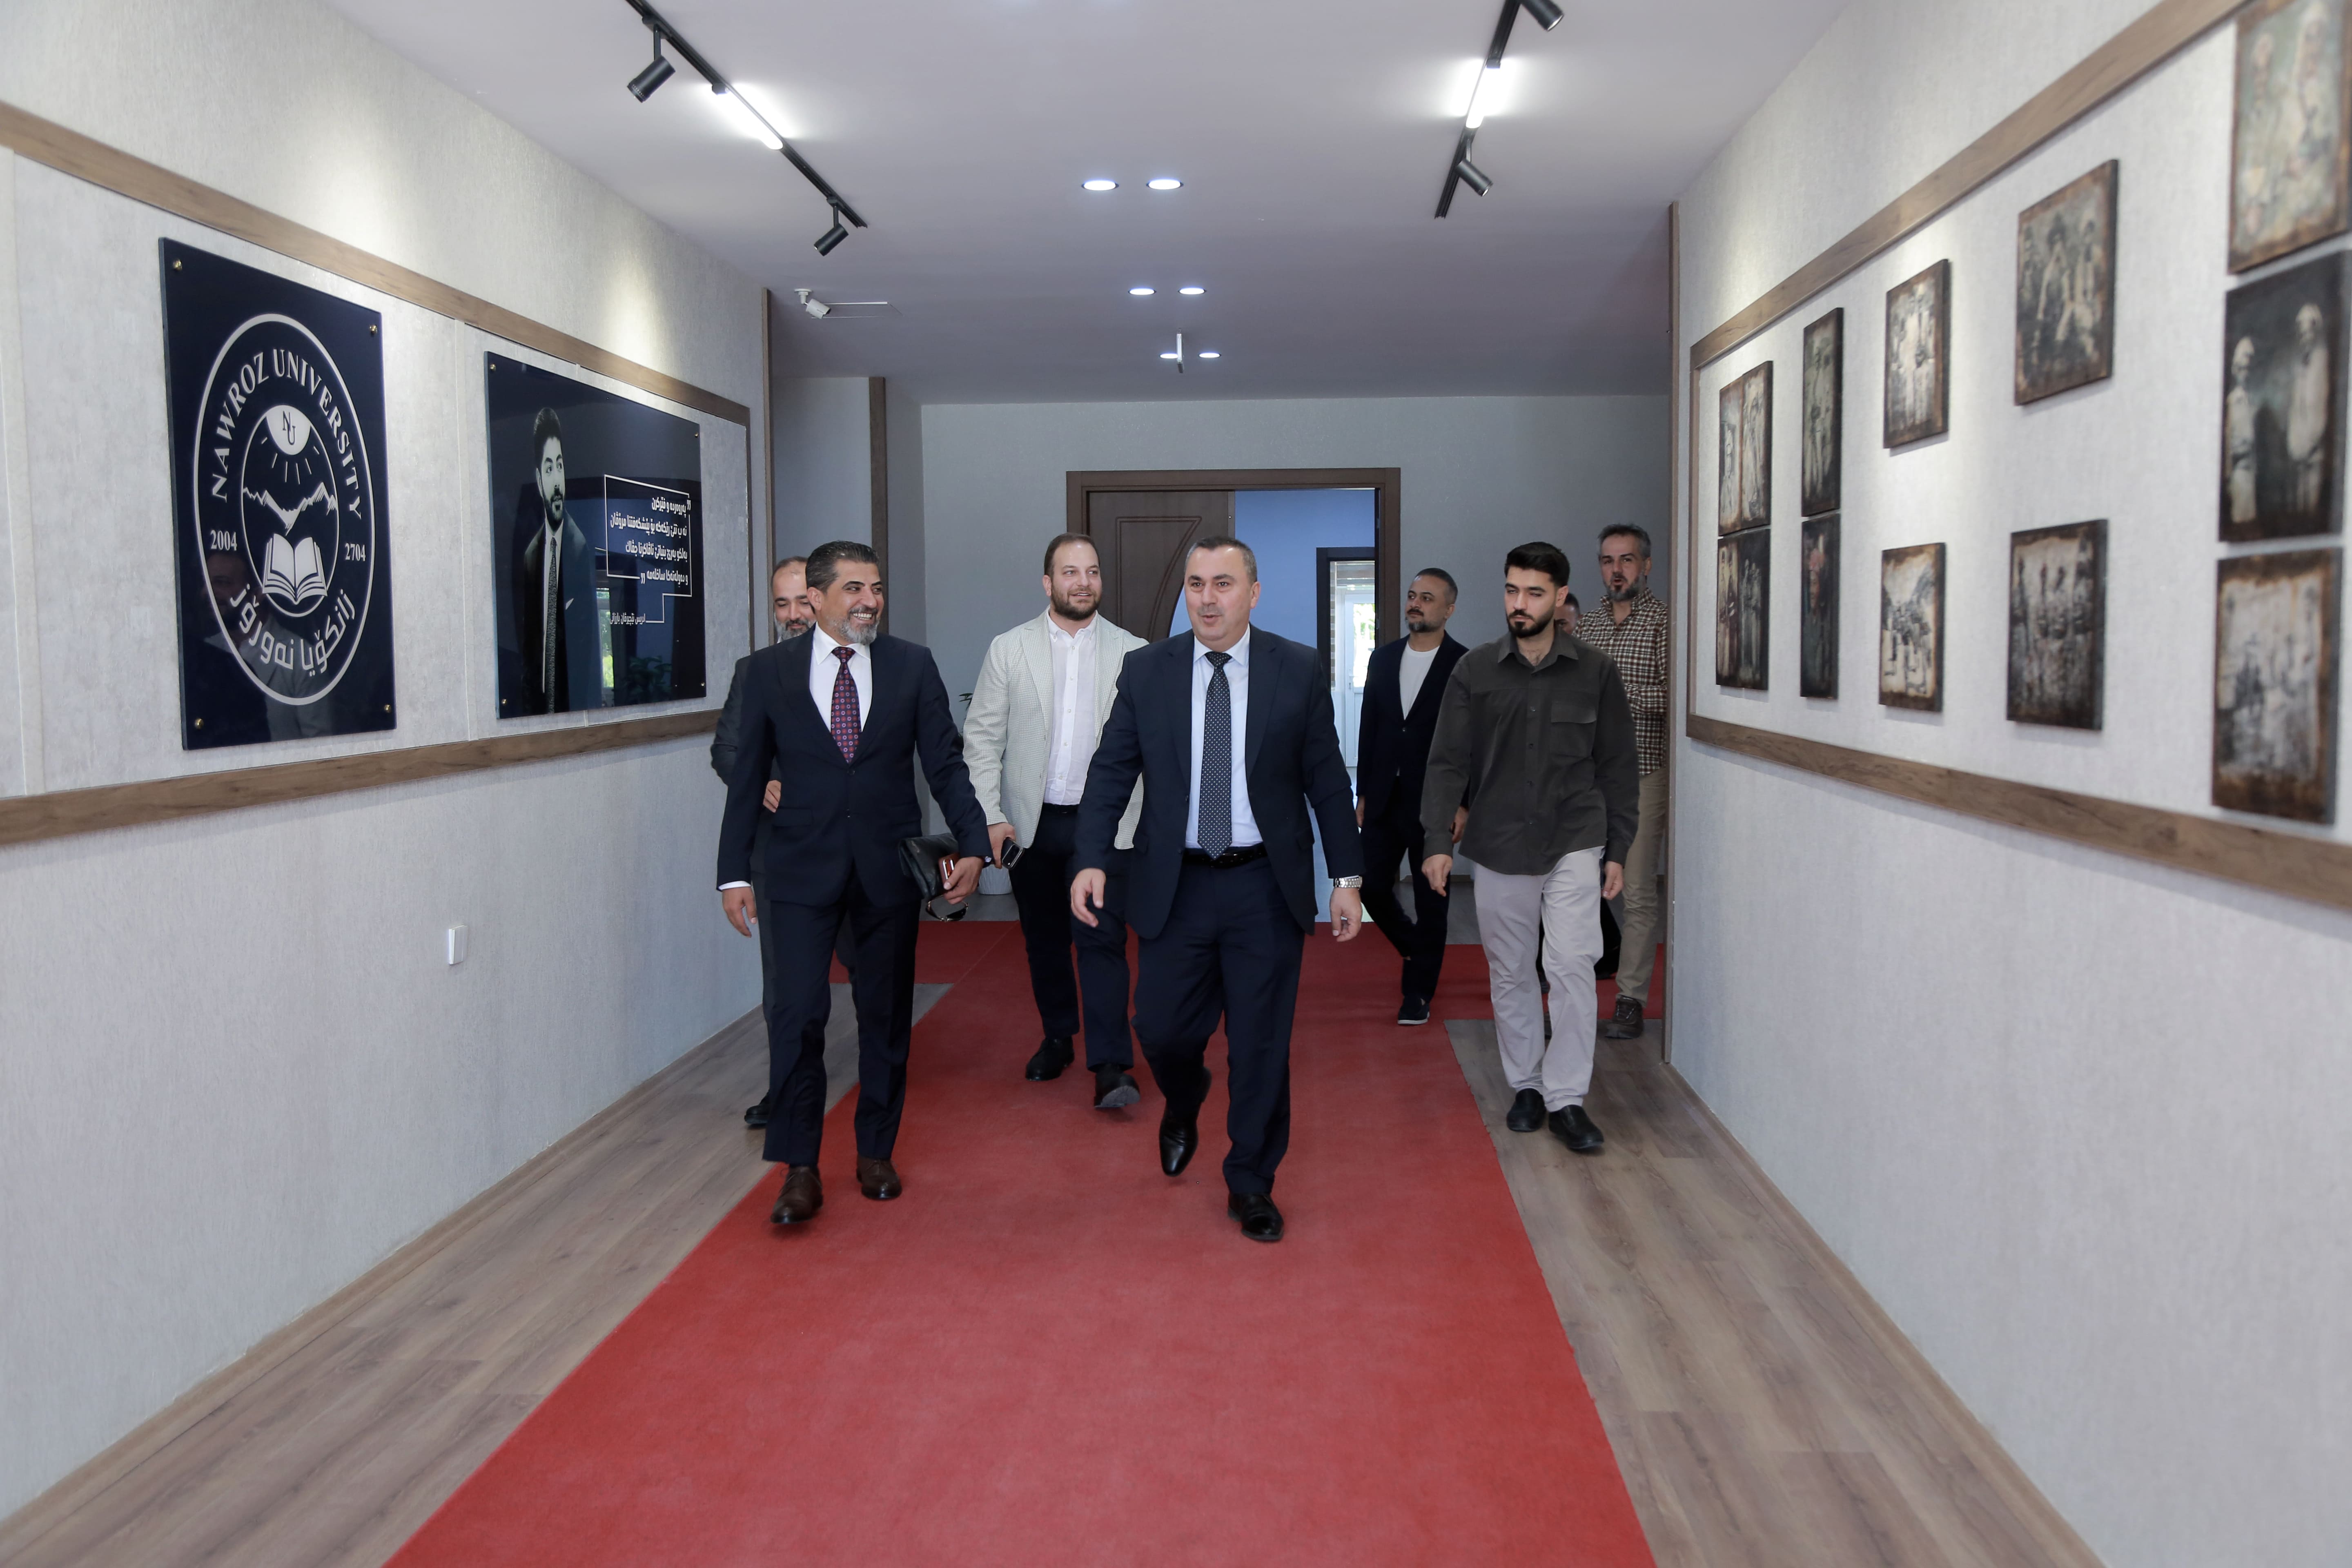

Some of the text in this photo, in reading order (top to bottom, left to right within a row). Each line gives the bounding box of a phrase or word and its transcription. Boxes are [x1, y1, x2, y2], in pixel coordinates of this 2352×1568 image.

[212, 349, 361, 520] NAWROZ UNIVERSITY
[666, 501, 670, 513] و
[650, 518, 655, 535] بۆ
[678, 528, 682, 538] ب
[682, 526, 687, 536] نە
[210, 530, 237, 552] 2004
[345, 543, 366, 562] 2704
[686, 575, 688, 585] و
